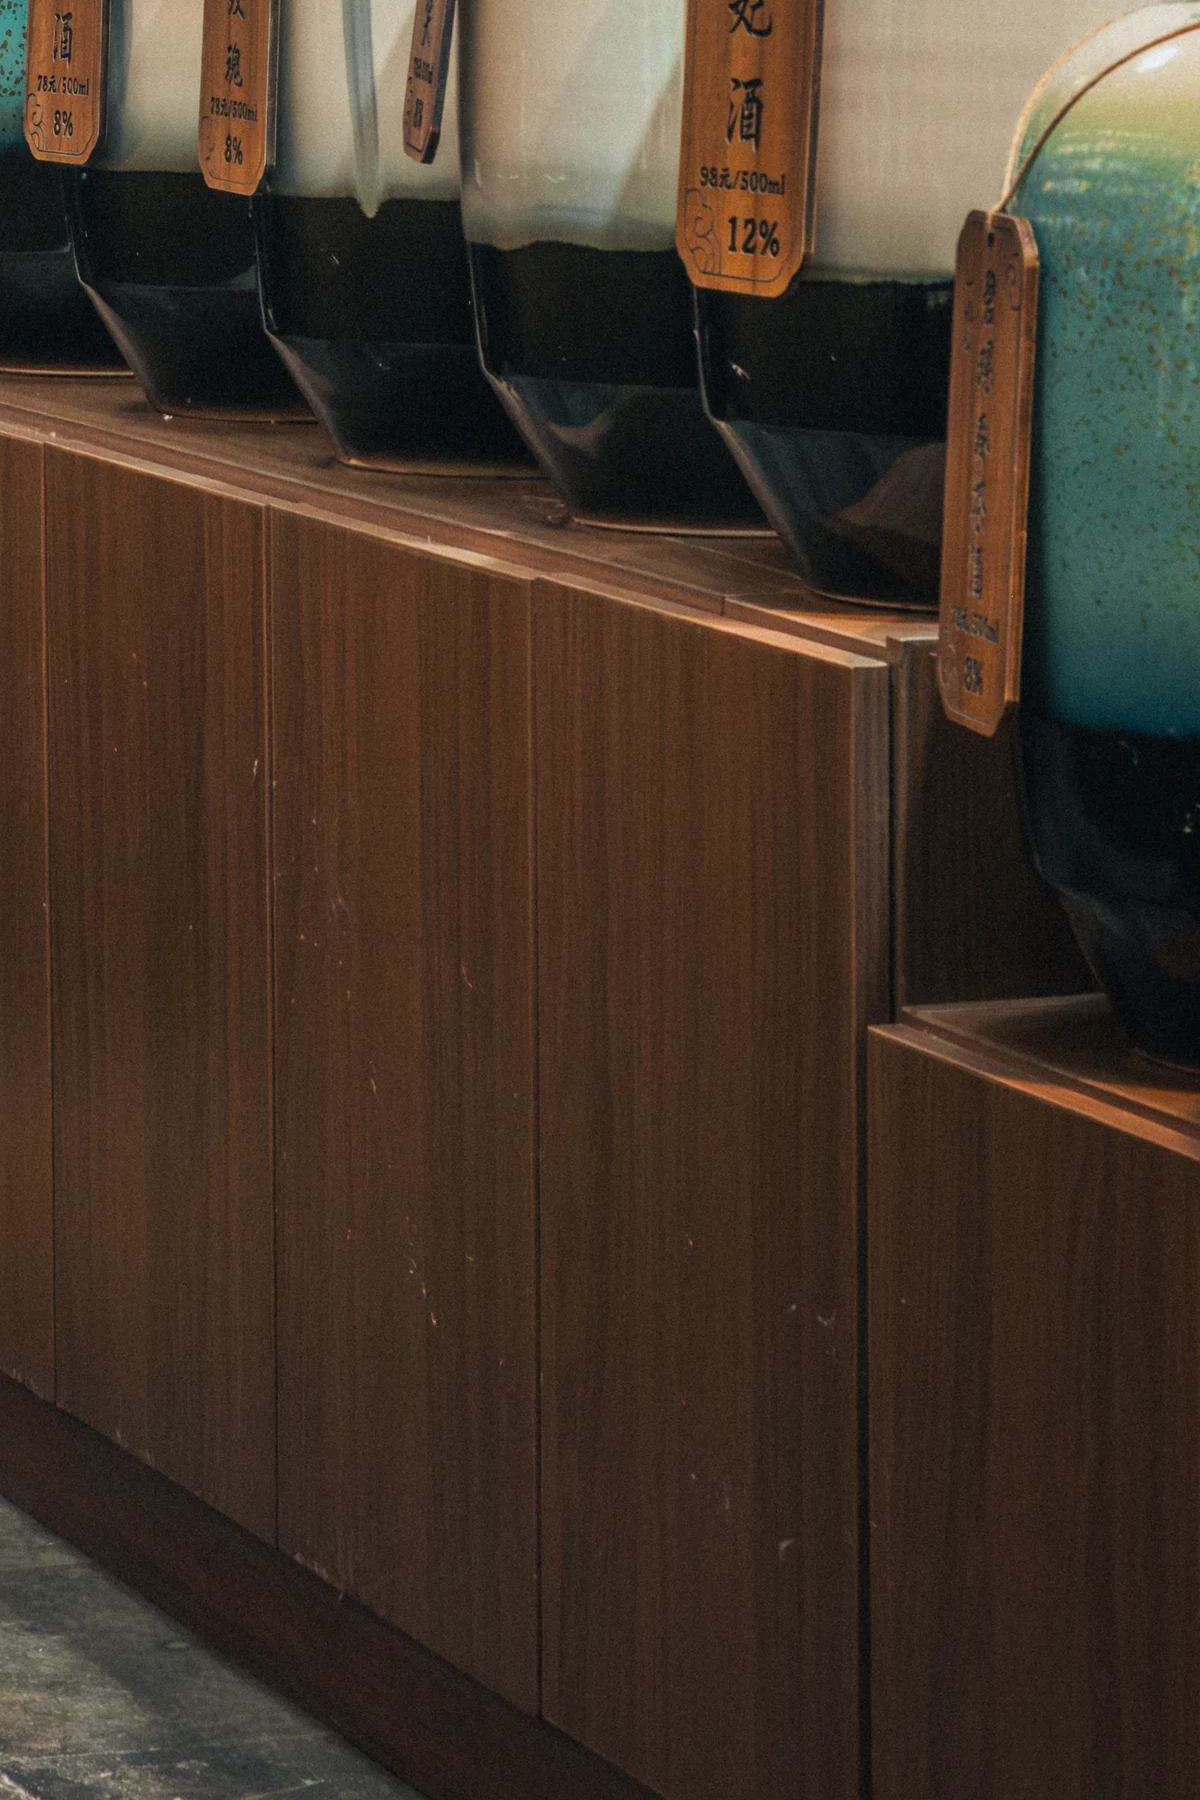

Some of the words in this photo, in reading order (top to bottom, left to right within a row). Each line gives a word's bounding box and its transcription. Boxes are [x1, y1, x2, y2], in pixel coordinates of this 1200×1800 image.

[37, 73, 90, 98] 78元/500ml
[53, 110, 74, 138] 8%
[224, 134, 244, 166] 8%
[699, 166, 786, 196] 98元/500ml
[726, 216, 781, 258] 12%
